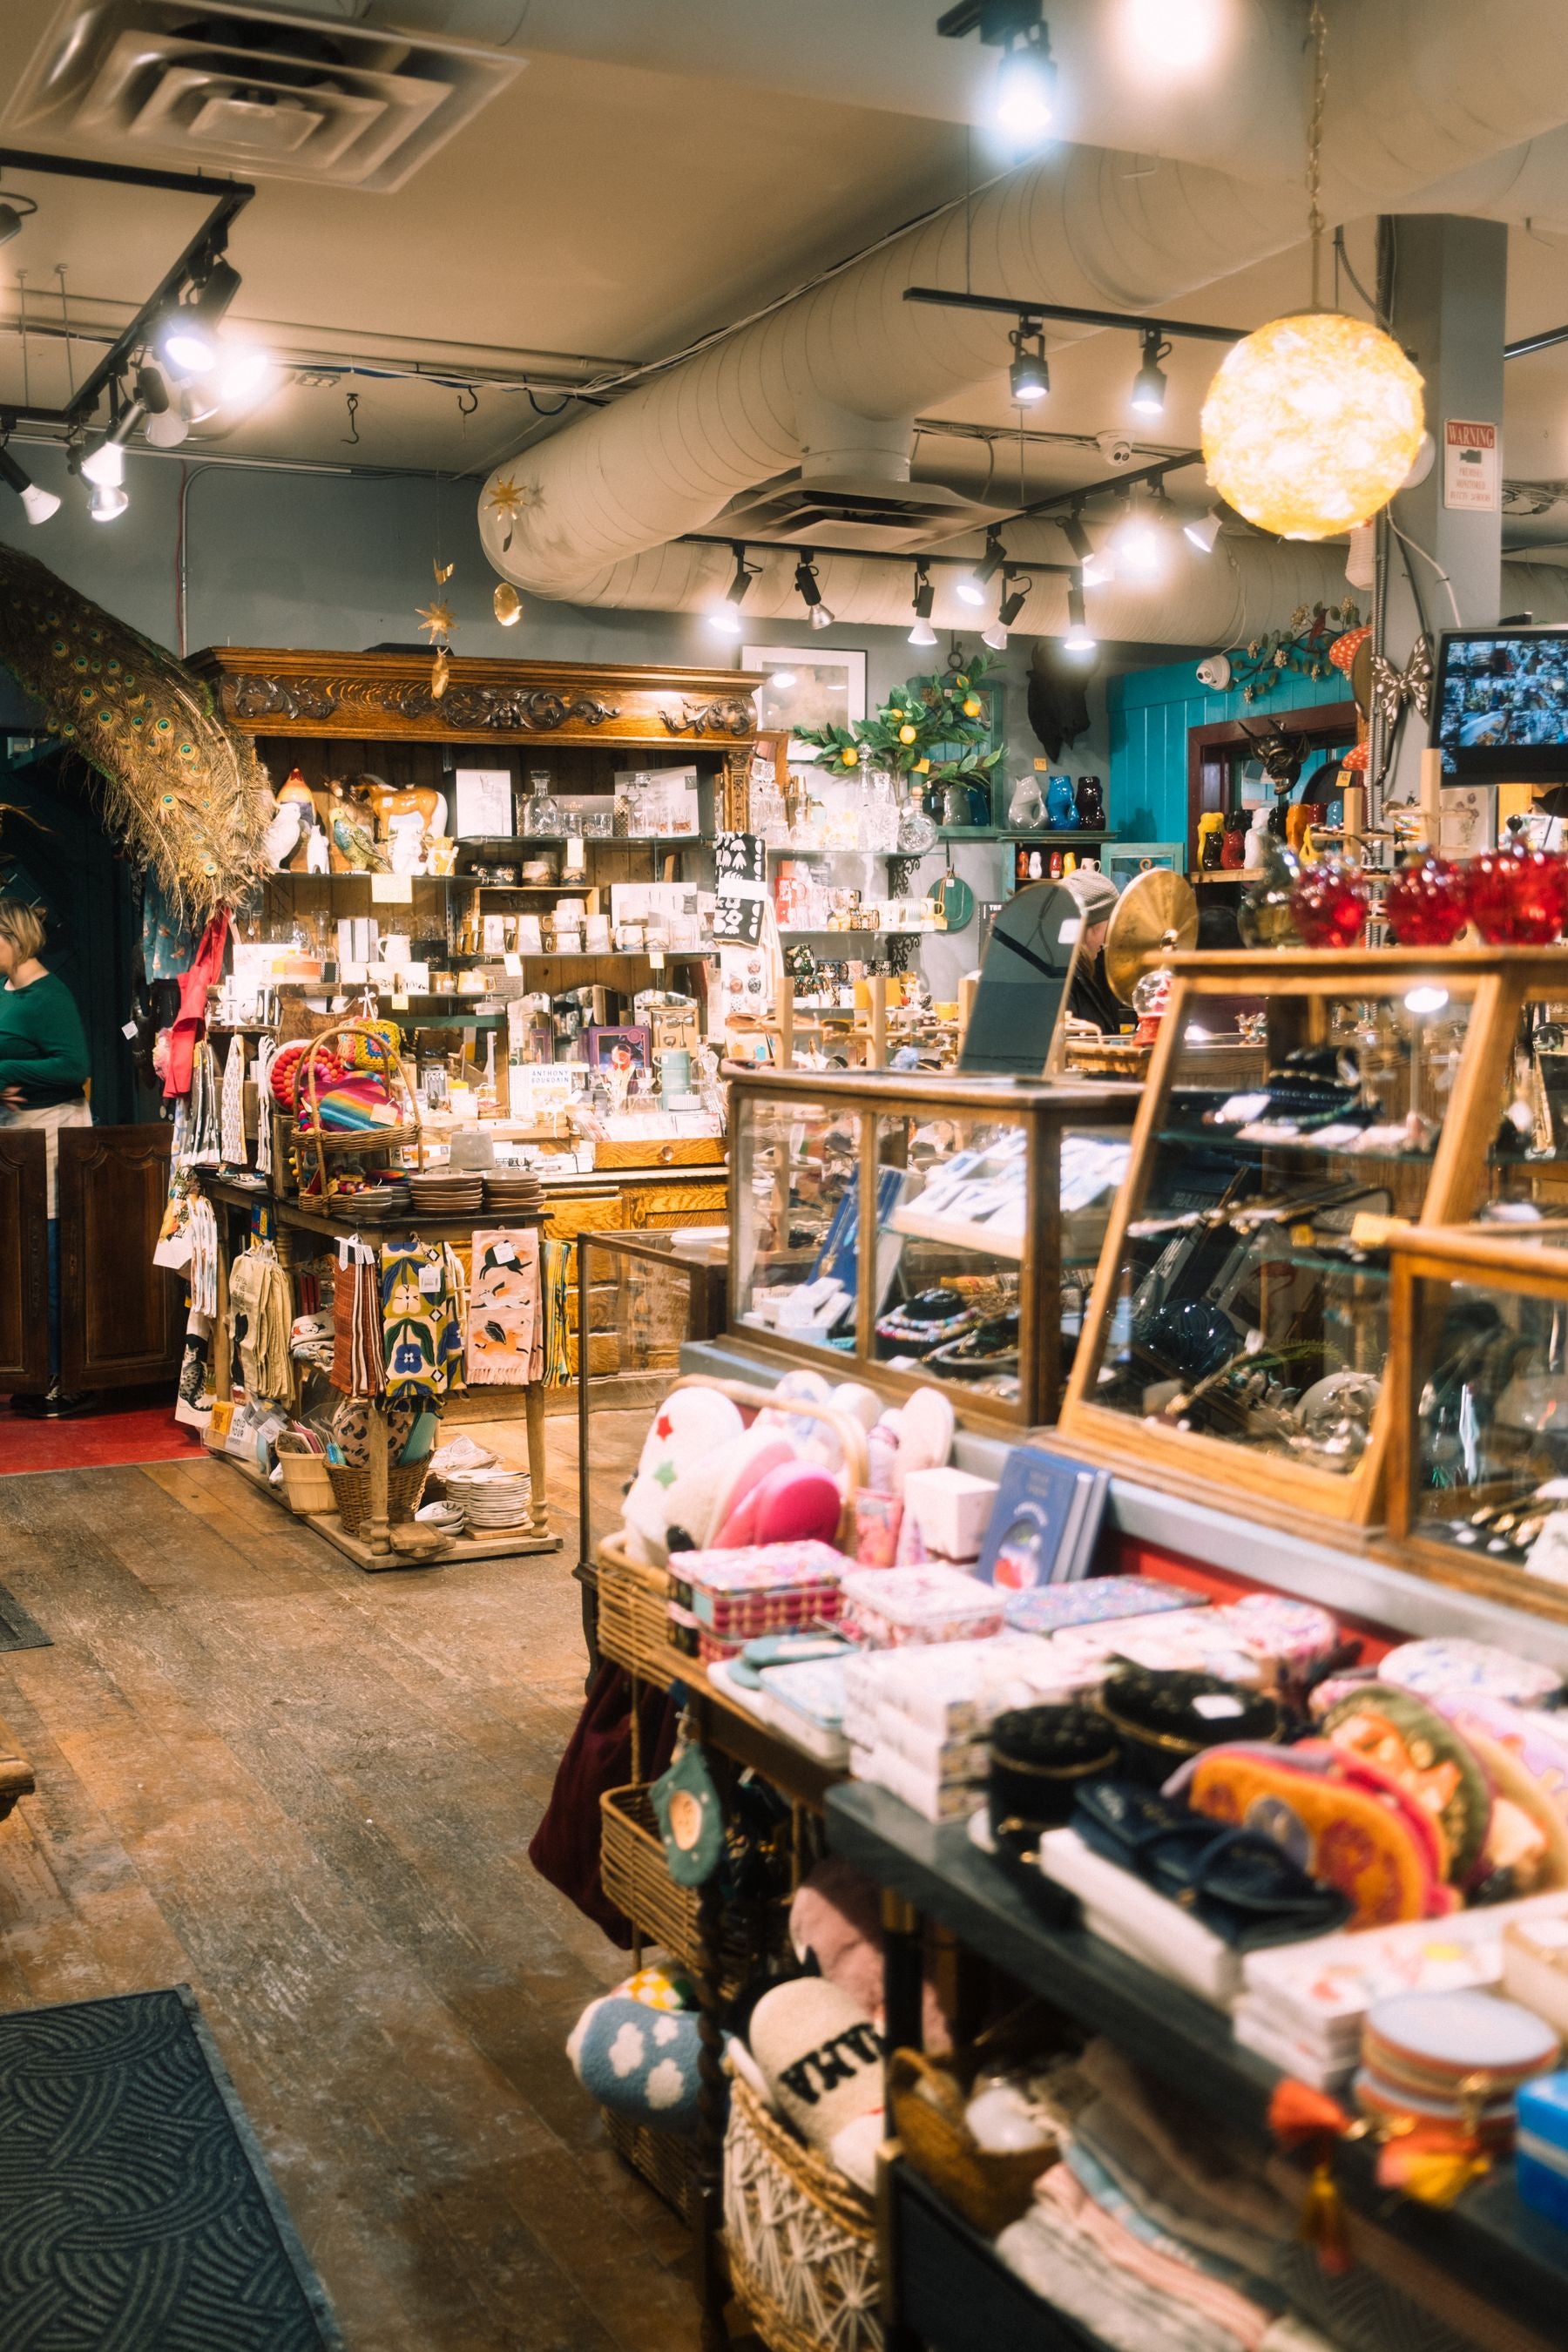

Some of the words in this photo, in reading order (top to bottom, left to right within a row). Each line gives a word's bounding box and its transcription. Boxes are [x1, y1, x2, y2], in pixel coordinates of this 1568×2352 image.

[1449, 425, 1493, 447] WARNING
[1456, 479, 1485, 490] MONITORED
[232, 1428, 244, 1437] YOUR
